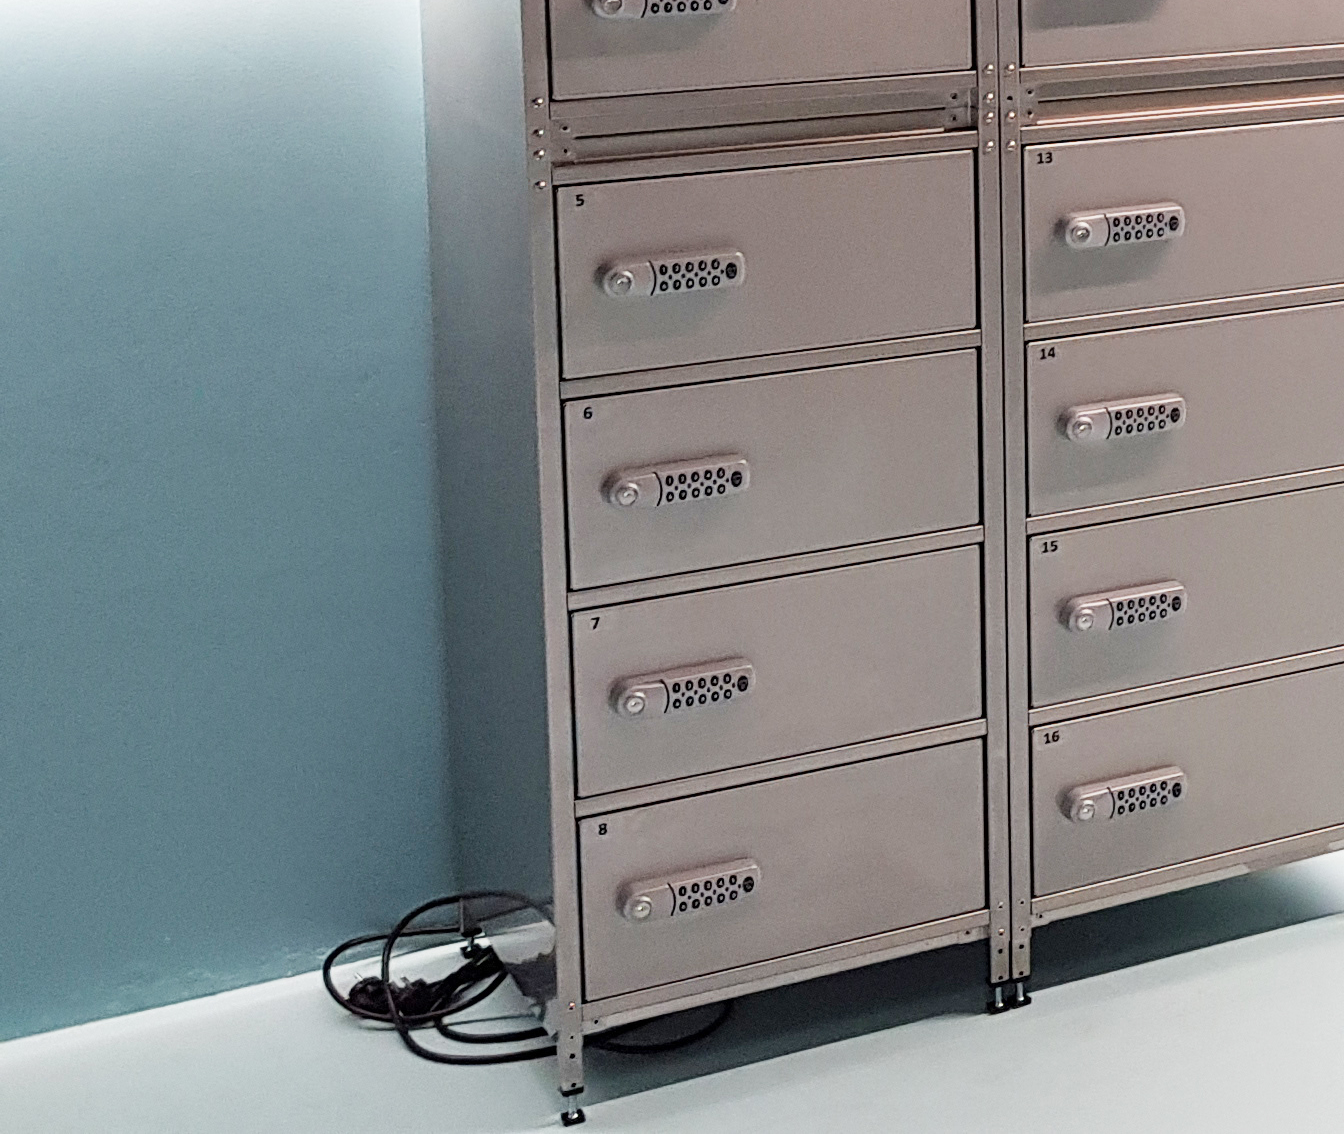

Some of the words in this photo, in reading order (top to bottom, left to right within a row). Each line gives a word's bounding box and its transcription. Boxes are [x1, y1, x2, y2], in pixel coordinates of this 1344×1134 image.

[1036, 151, 1053, 165] 13
[575, 193, 585, 207] 5
[1039, 346, 1056, 361] 14
[583, 406, 593, 420] 6
[1041, 540, 1059, 554] 15
[590, 616, 601, 630] 7
[1043, 730, 1060, 745] 16
[598, 822, 608, 836] 8
